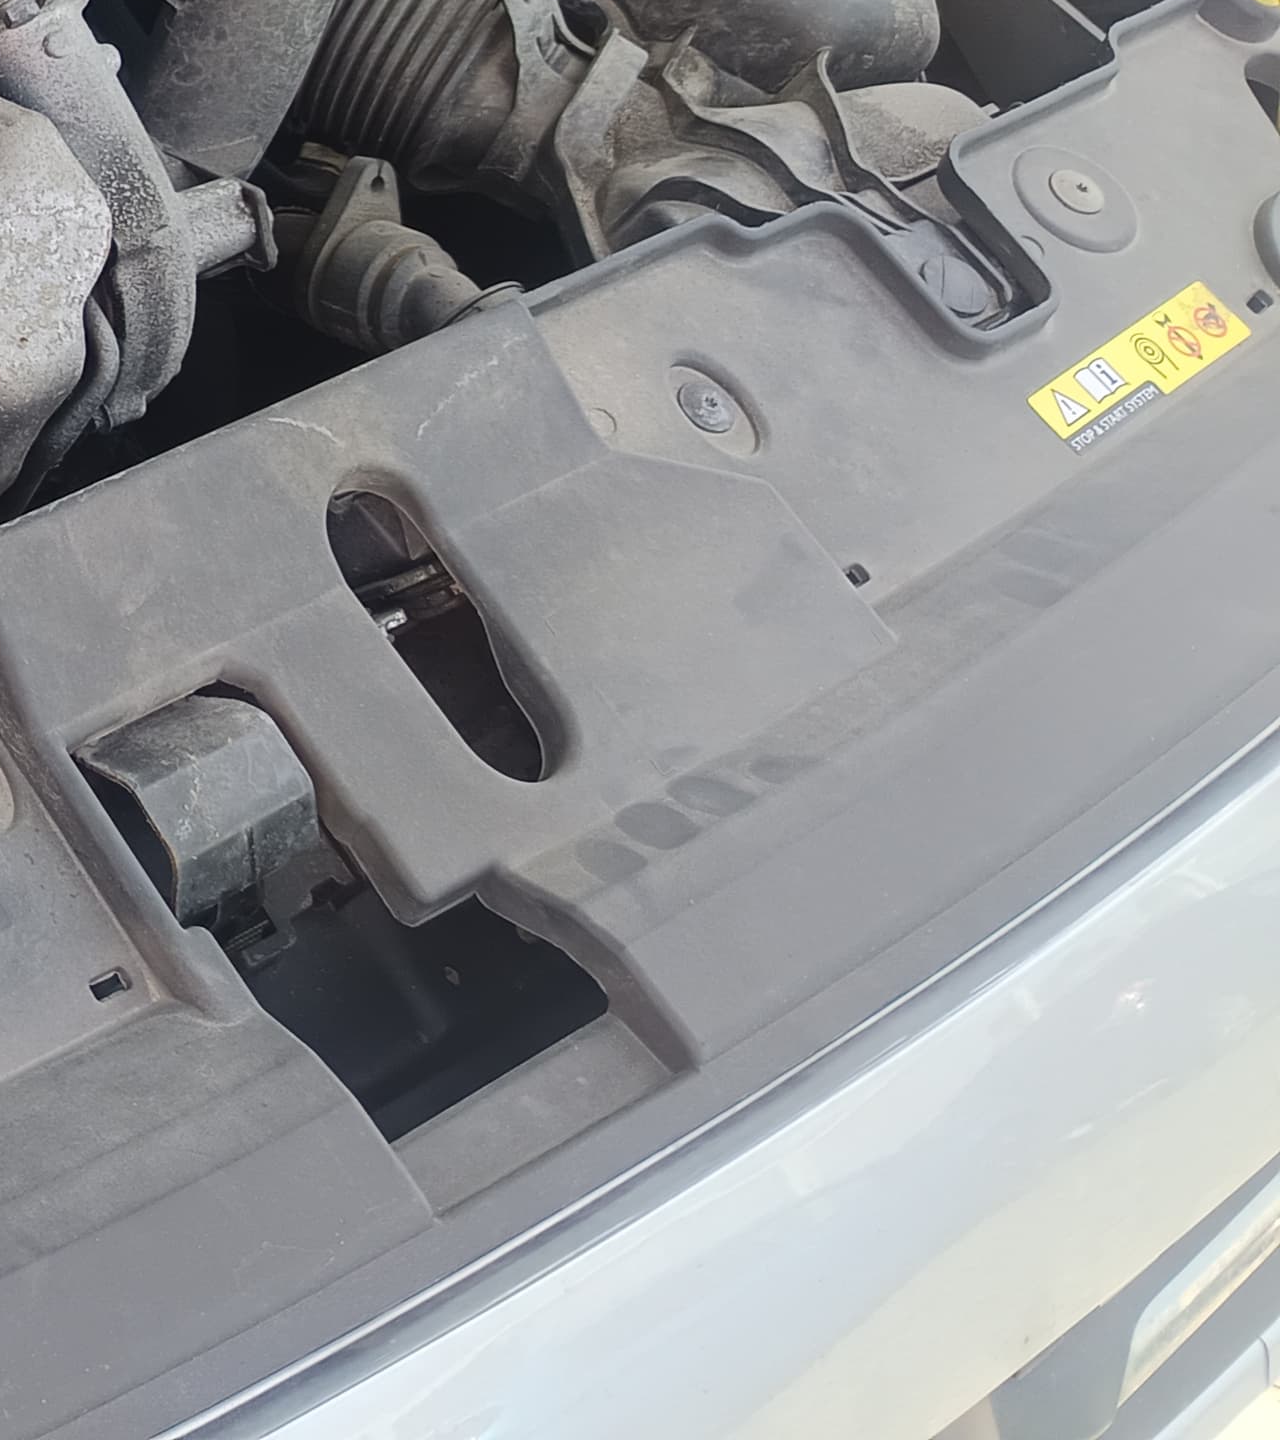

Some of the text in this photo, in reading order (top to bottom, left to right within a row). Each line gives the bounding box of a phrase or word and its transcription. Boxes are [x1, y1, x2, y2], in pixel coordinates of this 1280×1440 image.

[1071, 428, 1095, 451] STOP
[1099, 405, 1128, 431] START
[1124, 384, 1159, 413] SYSTEM
